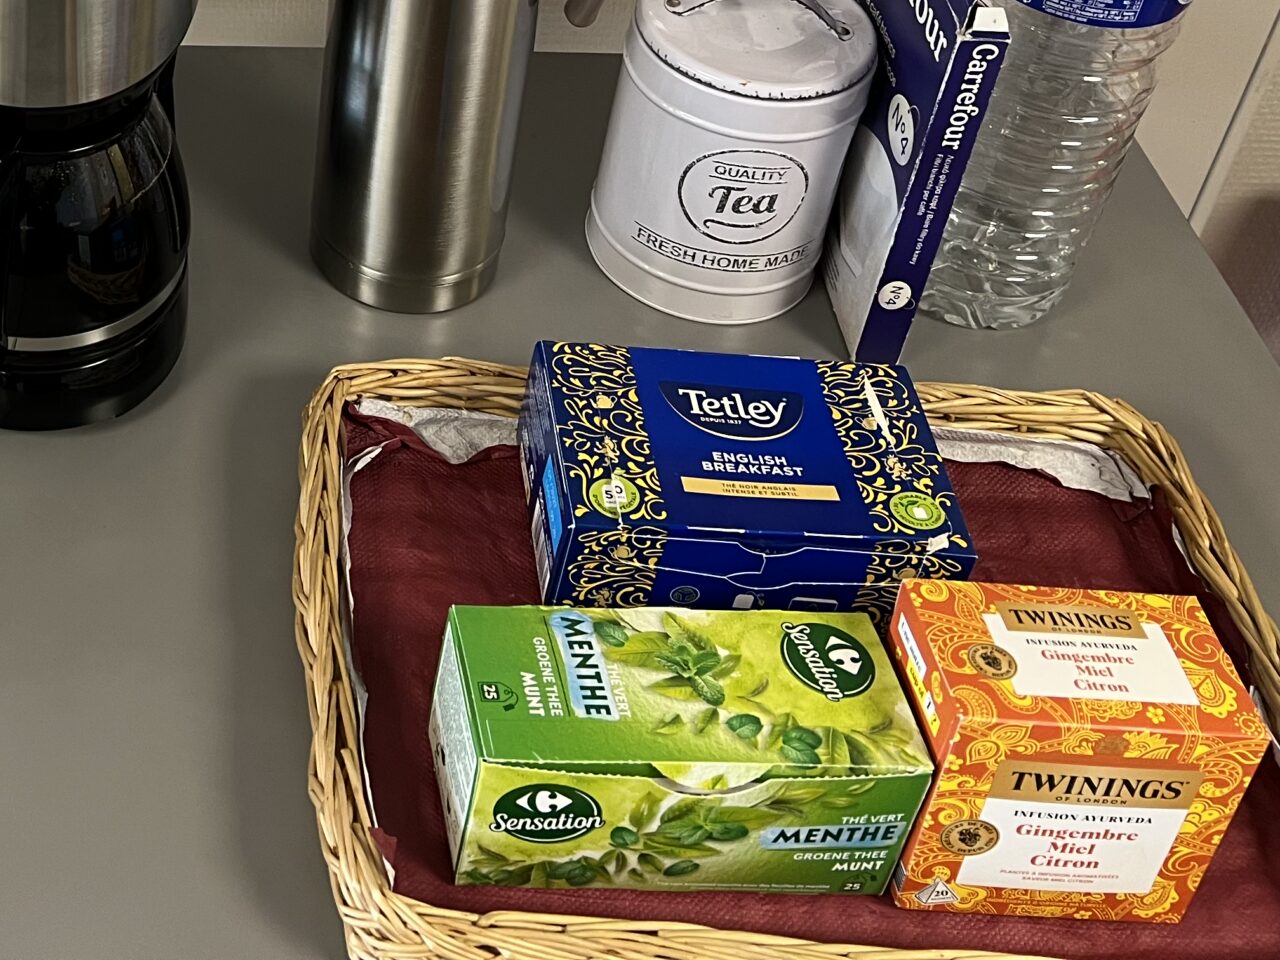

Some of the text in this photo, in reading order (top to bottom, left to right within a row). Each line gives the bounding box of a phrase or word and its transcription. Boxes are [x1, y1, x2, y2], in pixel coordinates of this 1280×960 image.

[941, 44, 999, 150] Carrefour
[714, 165, 787, 180] QUALITY
[708, 186, 779, 214] Tea
[637, 227, 809, 270] FRESH HOME MADE
[678, 389, 788, 428] Tetley
[700, 416, 726, 424] DEPUIS
[712, 451, 787, 465] ENGLISH
[702, 461, 803, 476] BREAKFAST
[1009, 608, 1128, 630] TWININGS
[1025, 638, 1138, 651] INFUSION AYURVEDA
[782, 623, 843, 701] Sensation
[1041, 649, 1134, 665] Gingembre
[560, 616, 611, 716] MENTHE
[1076, 663, 1113, 677] Miel
[533, 637, 563, 716] GROENE THEE
[483, 685, 497, 700] 25
[1074, 678, 1130, 693] Citron
[520, 671, 545, 716] MUNT
[614, 690, 631, 718] VERT
[1011, 771, 1185, 800] TWININGS
[1055, 795, 1127, 806] OF LONDON
[490, 812, 604, 834] Sensation
[842, 813, 904, 825] THÉ VERT
[1014, 810, 1153, 824] INFUSION AYURVEDA
[772, 826, 897, 843] MENTHE
[1015, 823, 1139, 842] Gingembre
[792, 850, 888, 861] GROENE THEE
[1046, 841, 1095, 855] Miel
[831, 861, 884, 871] MUNT
[1030, 855, 1100, 869] Citron
[843, 882, 862, 891] 25
